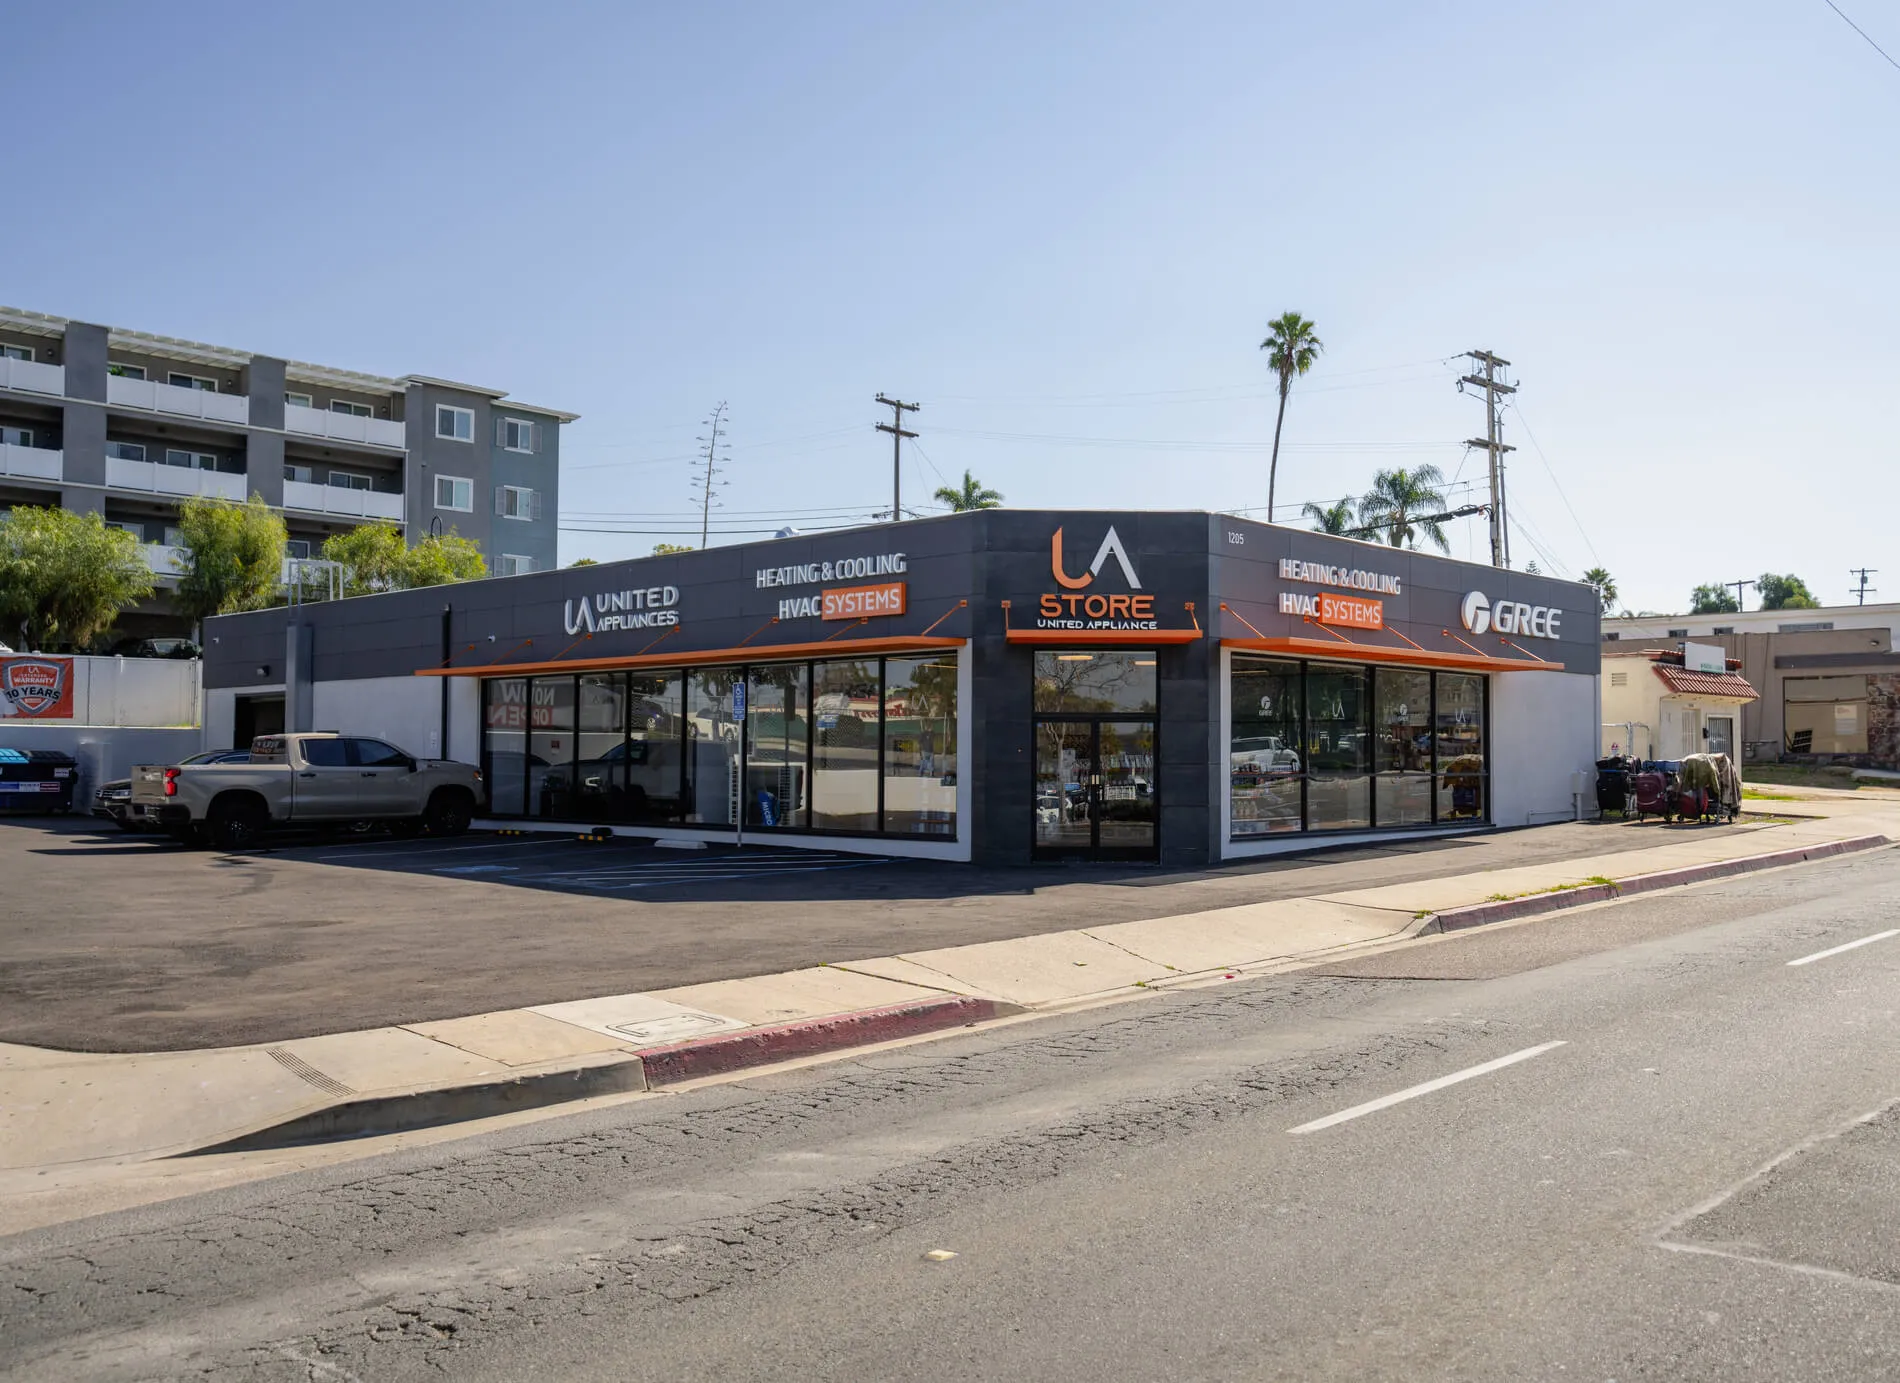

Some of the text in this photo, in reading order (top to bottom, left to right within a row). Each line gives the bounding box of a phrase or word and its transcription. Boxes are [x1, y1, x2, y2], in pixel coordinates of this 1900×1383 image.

[1228, 532, 1244, 544] 1205
[756, 553, 907, 588] HEATING & COOLING
[1279, 558, 1401, 595] HEATING & COOLING
[596, 586, 680, 613] UNITED
[779, 588, 900, 620] HVAC SYSTEMS
[1040, 594, 1155, 618] STORE
[1279, 592, 1381, 625] HVAC SYSTEMS
[596, 610, 680, 632] APPLIANCES
[1037, 619, 1158, 630] UNITED APPLIANCE
[1490, 600, 1562, 640] GREE
[6, 687, 61, 700] 10 YEARS
